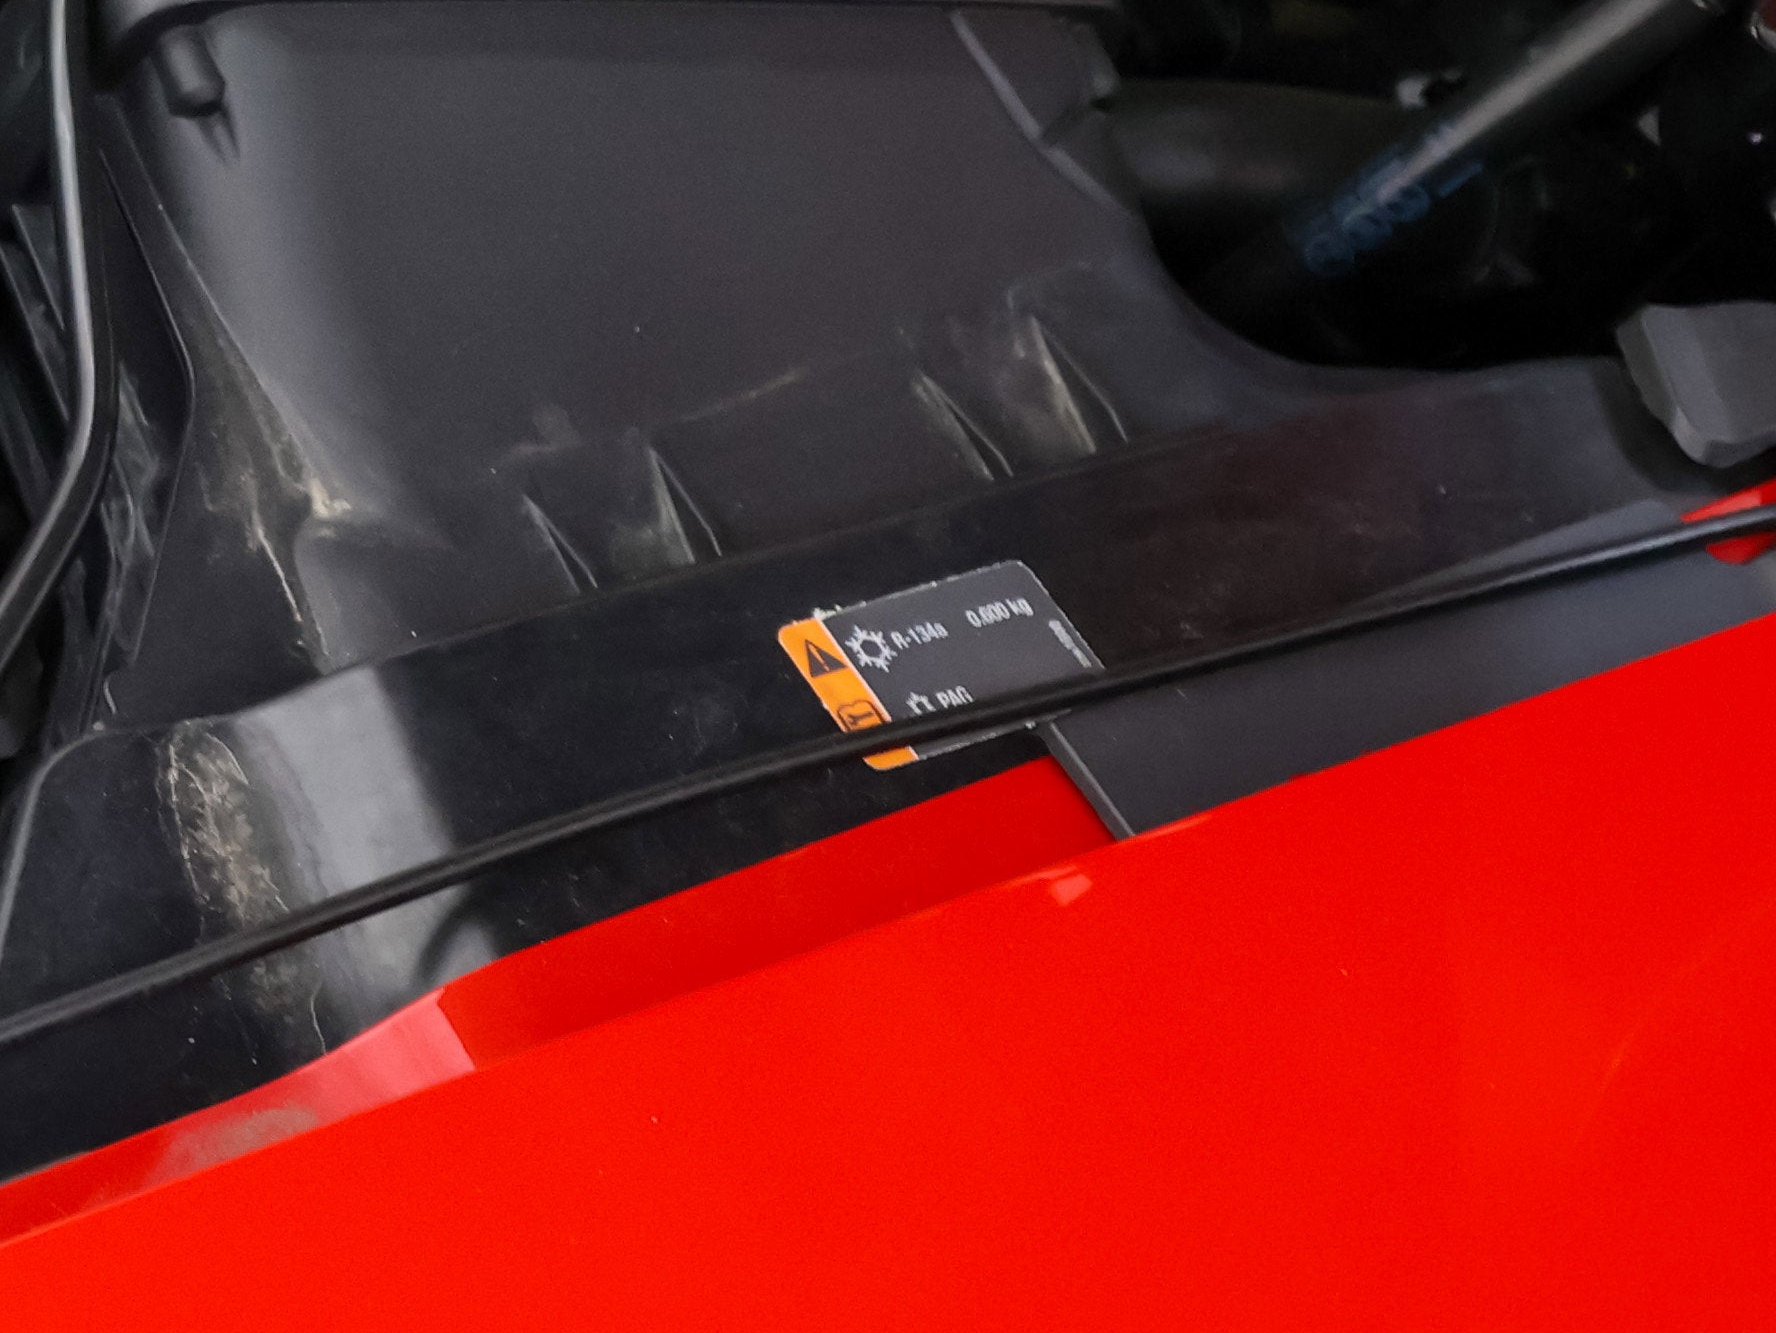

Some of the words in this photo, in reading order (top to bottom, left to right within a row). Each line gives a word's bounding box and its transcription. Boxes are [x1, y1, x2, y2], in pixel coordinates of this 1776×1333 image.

[891, 622, 948, 650] R-134a
[1007, 597, 1034, 616] kg
[935, 686, 974, 709] PAG
